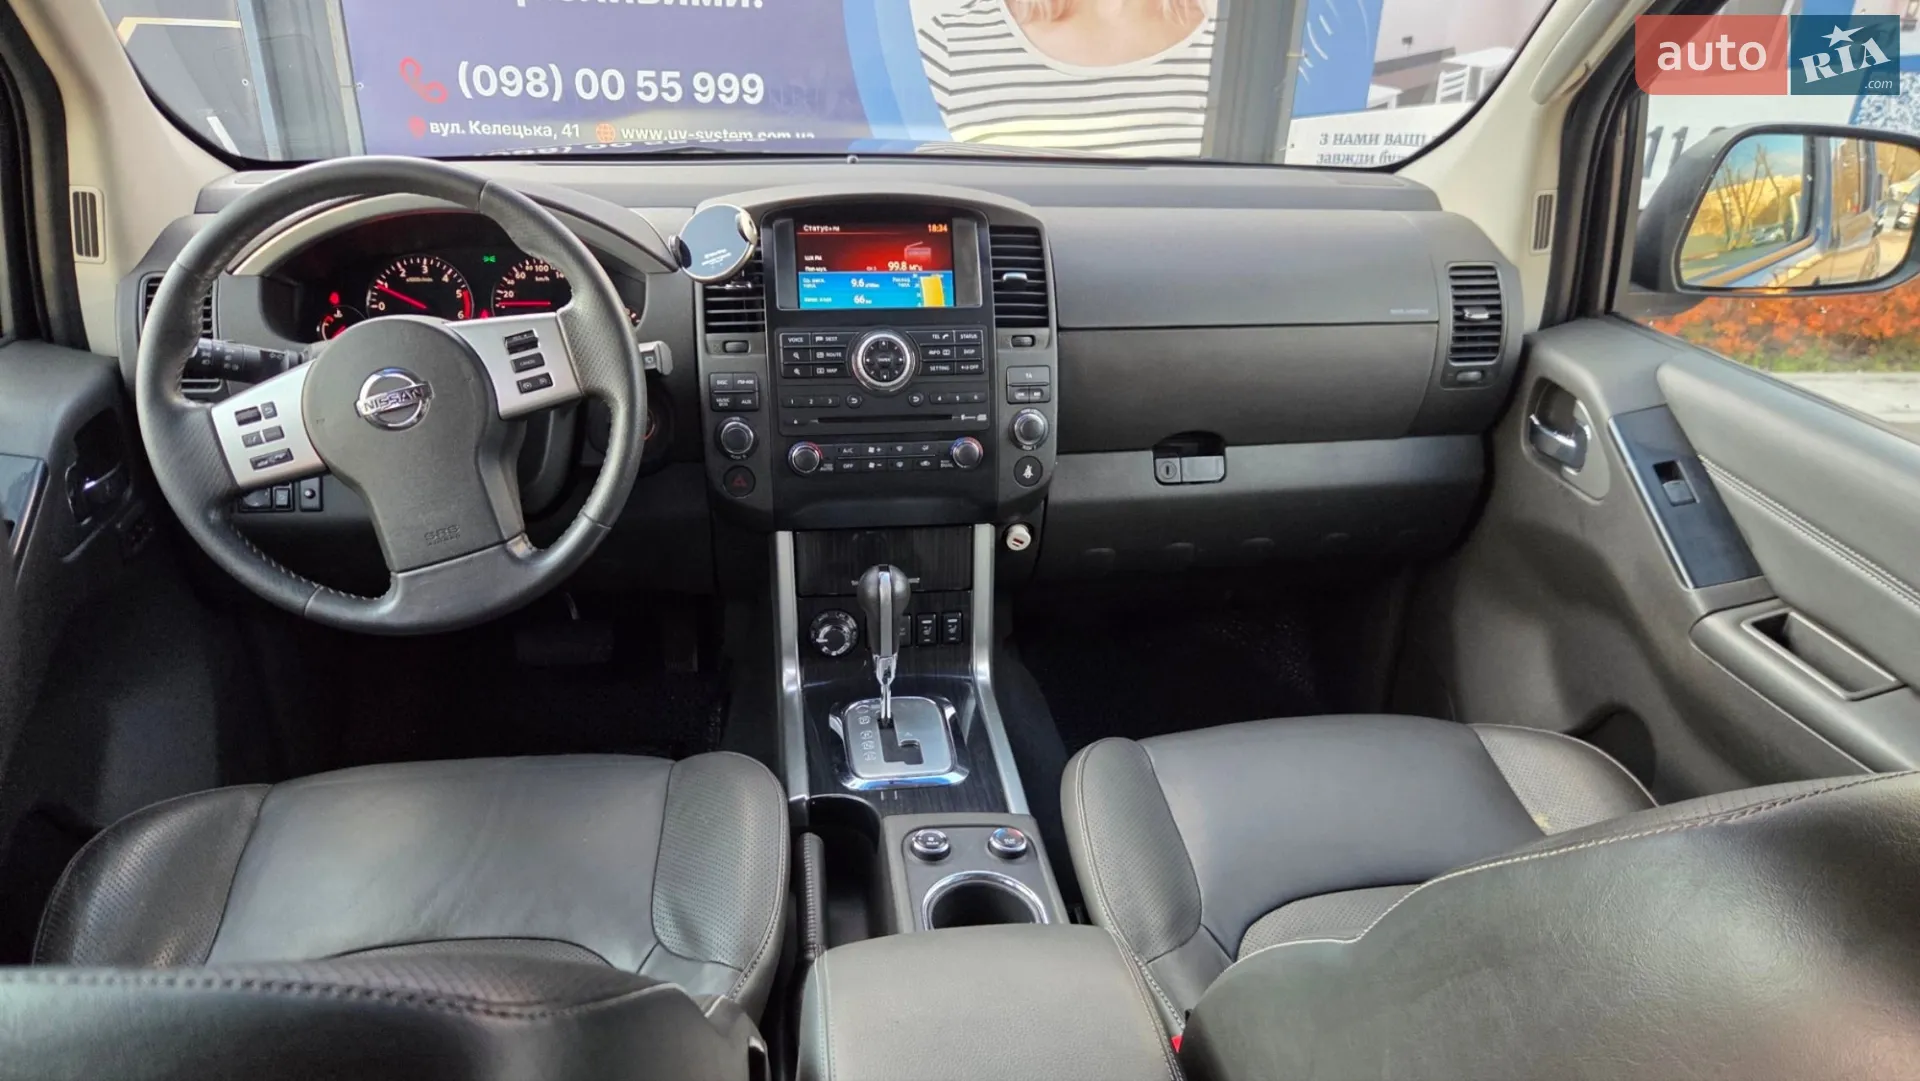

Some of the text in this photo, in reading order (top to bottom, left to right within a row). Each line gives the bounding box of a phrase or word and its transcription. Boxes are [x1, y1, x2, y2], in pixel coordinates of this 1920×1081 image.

[458, 61, 765, 105] (098) 00 55 999
[429, 120, 581, 140] вул. Келецька, 41
[1332, 133, 1380, 147] НАМИ
[1316, 152, 1376, 166] завжди
[421, 265, 428, 274] 3
[535, 264, 549, 272] 100
[888, 261, 907, 272] 99.8
[400, 268, 406, 277] 2
[515, 271, 526, 280] 60
[441, 273, 449, 283] 4
[851, 278, 865, 288] 9.6
[456, 288, 463, 298] 5
[503, 290, 514, 298] 20
[378, 301, 386, 311] 0
[457, 310, 464, 319] 6
[363, 387, 425, 413] NISSAN
